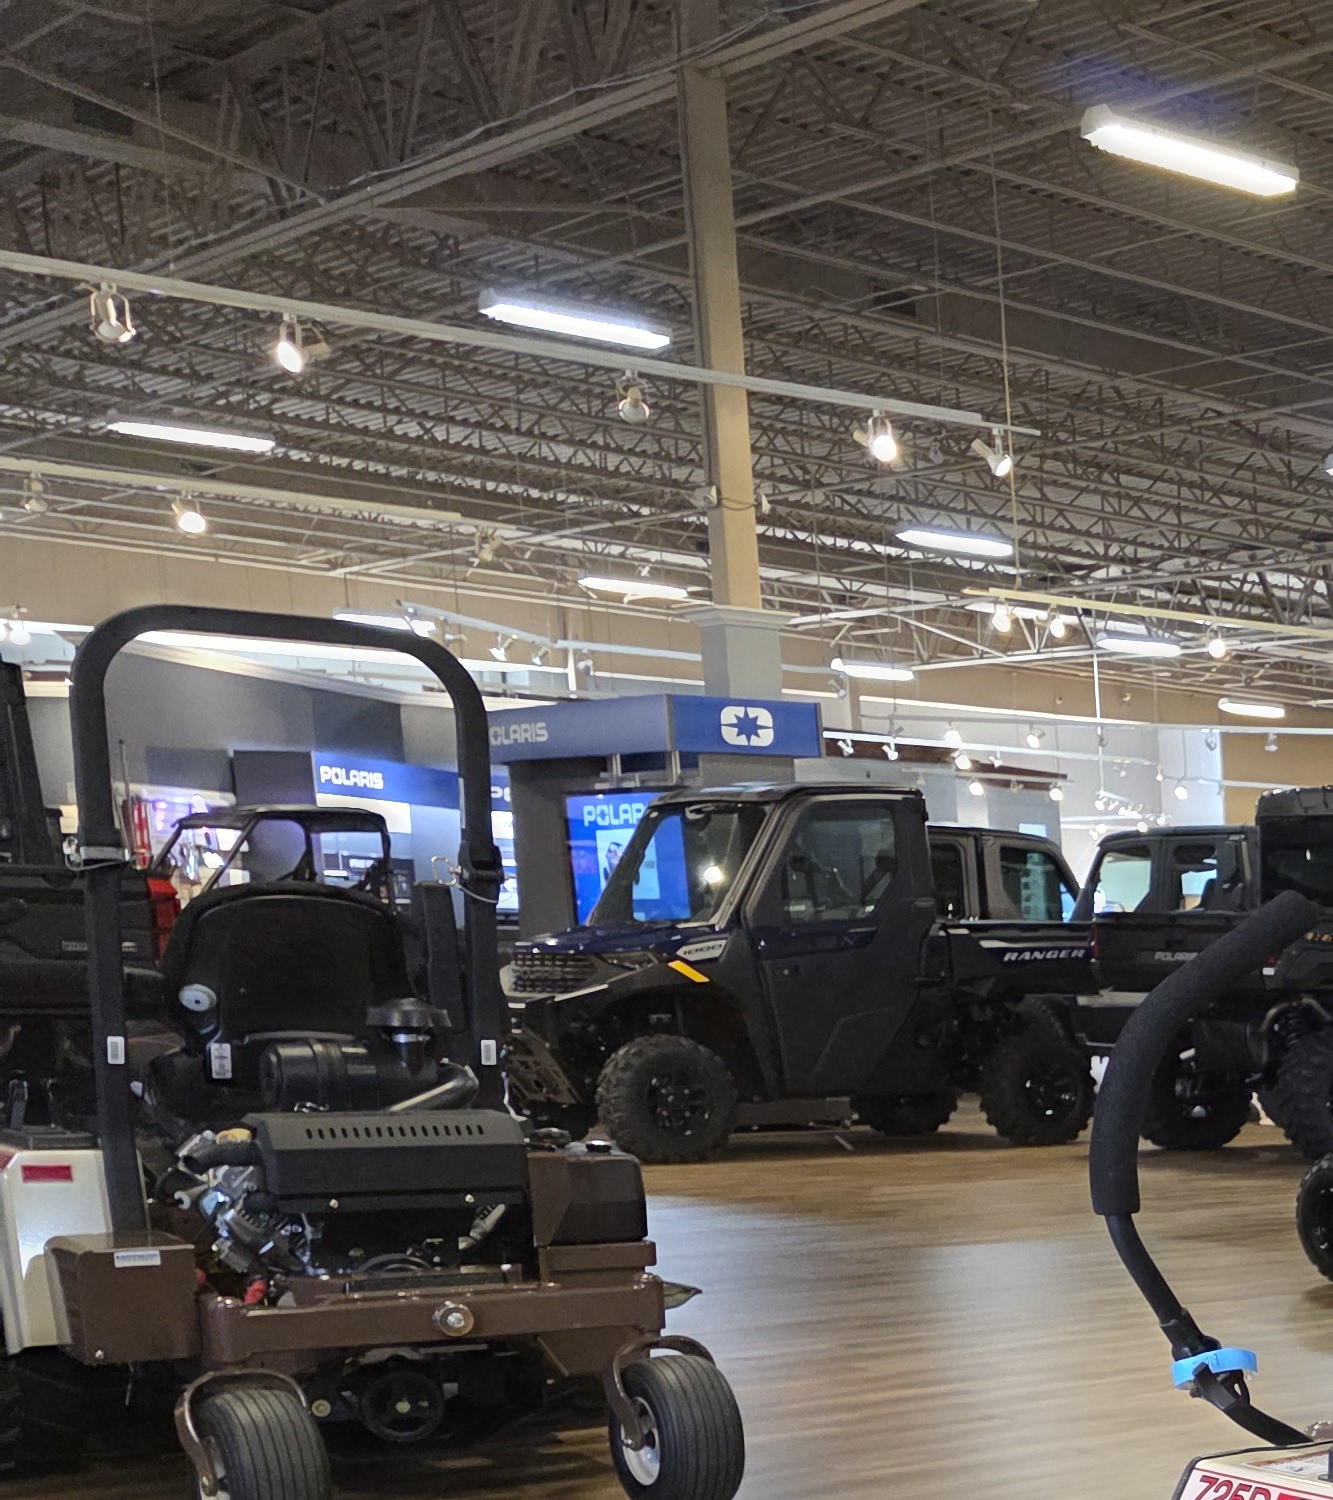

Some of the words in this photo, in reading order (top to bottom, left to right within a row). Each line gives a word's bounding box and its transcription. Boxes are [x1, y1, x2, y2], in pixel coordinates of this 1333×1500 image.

[488, 721, 549, 747] OLARIS
[319, 765, 384, 790] POLARIS
[583, 802, 646, 828] POLAR
[1004, 948, 1086, 963] RANGER
